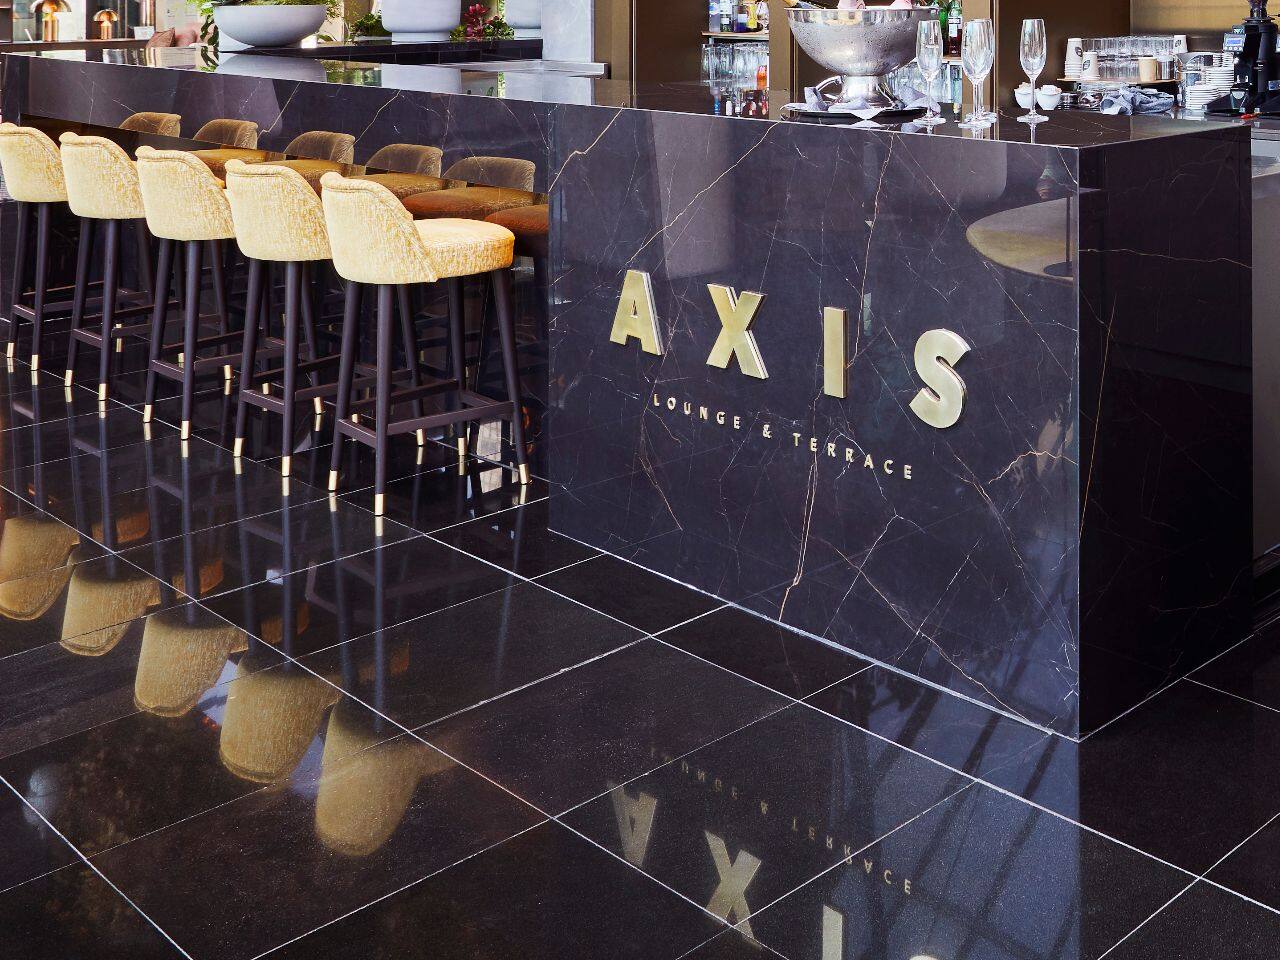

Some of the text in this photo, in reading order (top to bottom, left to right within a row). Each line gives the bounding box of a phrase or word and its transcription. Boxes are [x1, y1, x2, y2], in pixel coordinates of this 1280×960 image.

[610, 269, 971, 429] AXIS
[653, 393, 913, 480] LOUNGE & TERRACE
